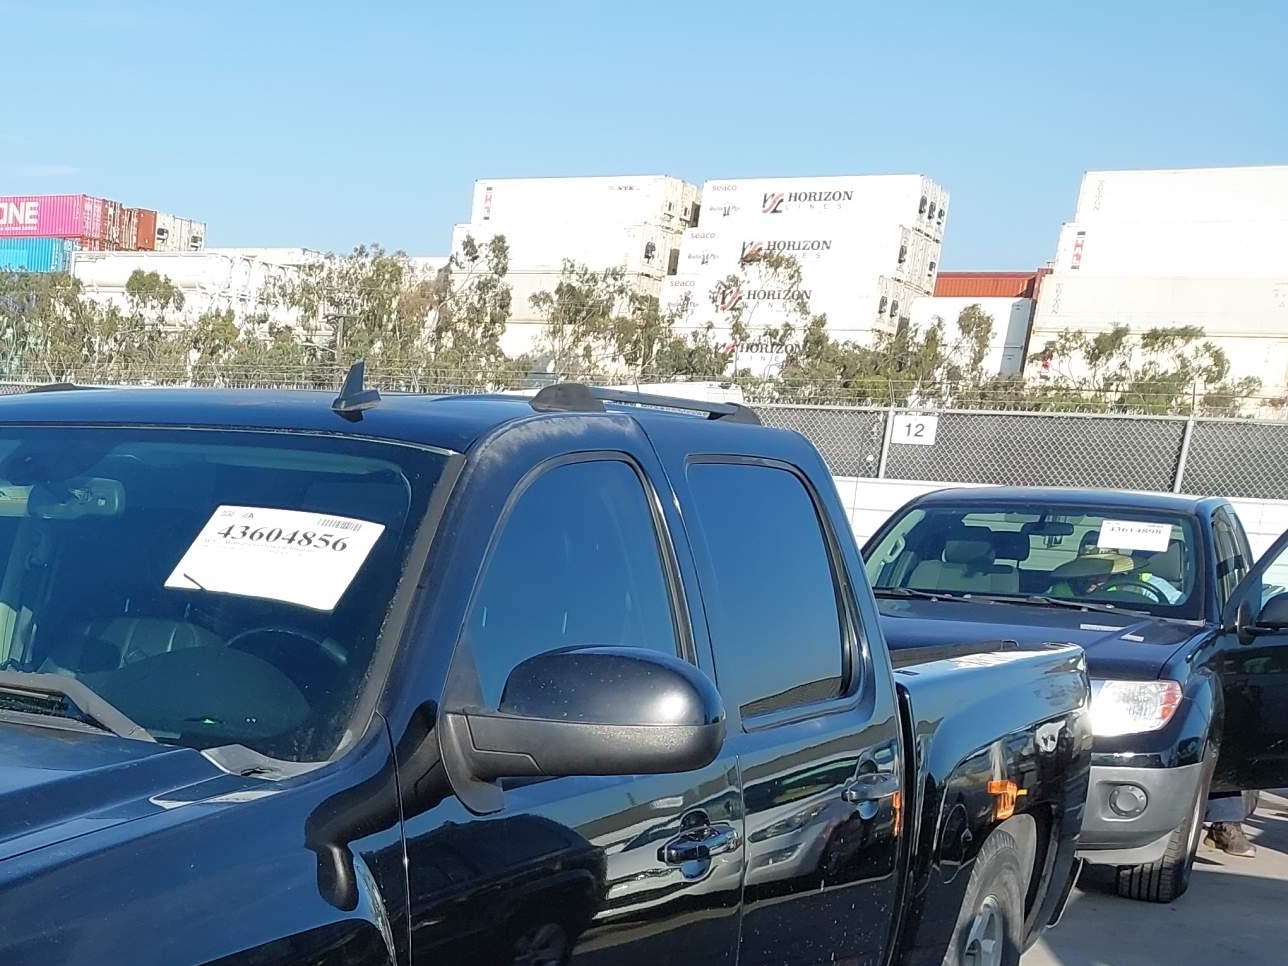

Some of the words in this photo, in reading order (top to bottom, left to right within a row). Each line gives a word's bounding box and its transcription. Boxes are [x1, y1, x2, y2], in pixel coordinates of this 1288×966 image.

[788, 191, 854, 202] HORIZON
[766, 241, 832, 251] HORIZON
[746, 290, 812, 301] HORIZON
[905, 423, 925, 438] 12
[217, 523, 351, 552] 43604856
